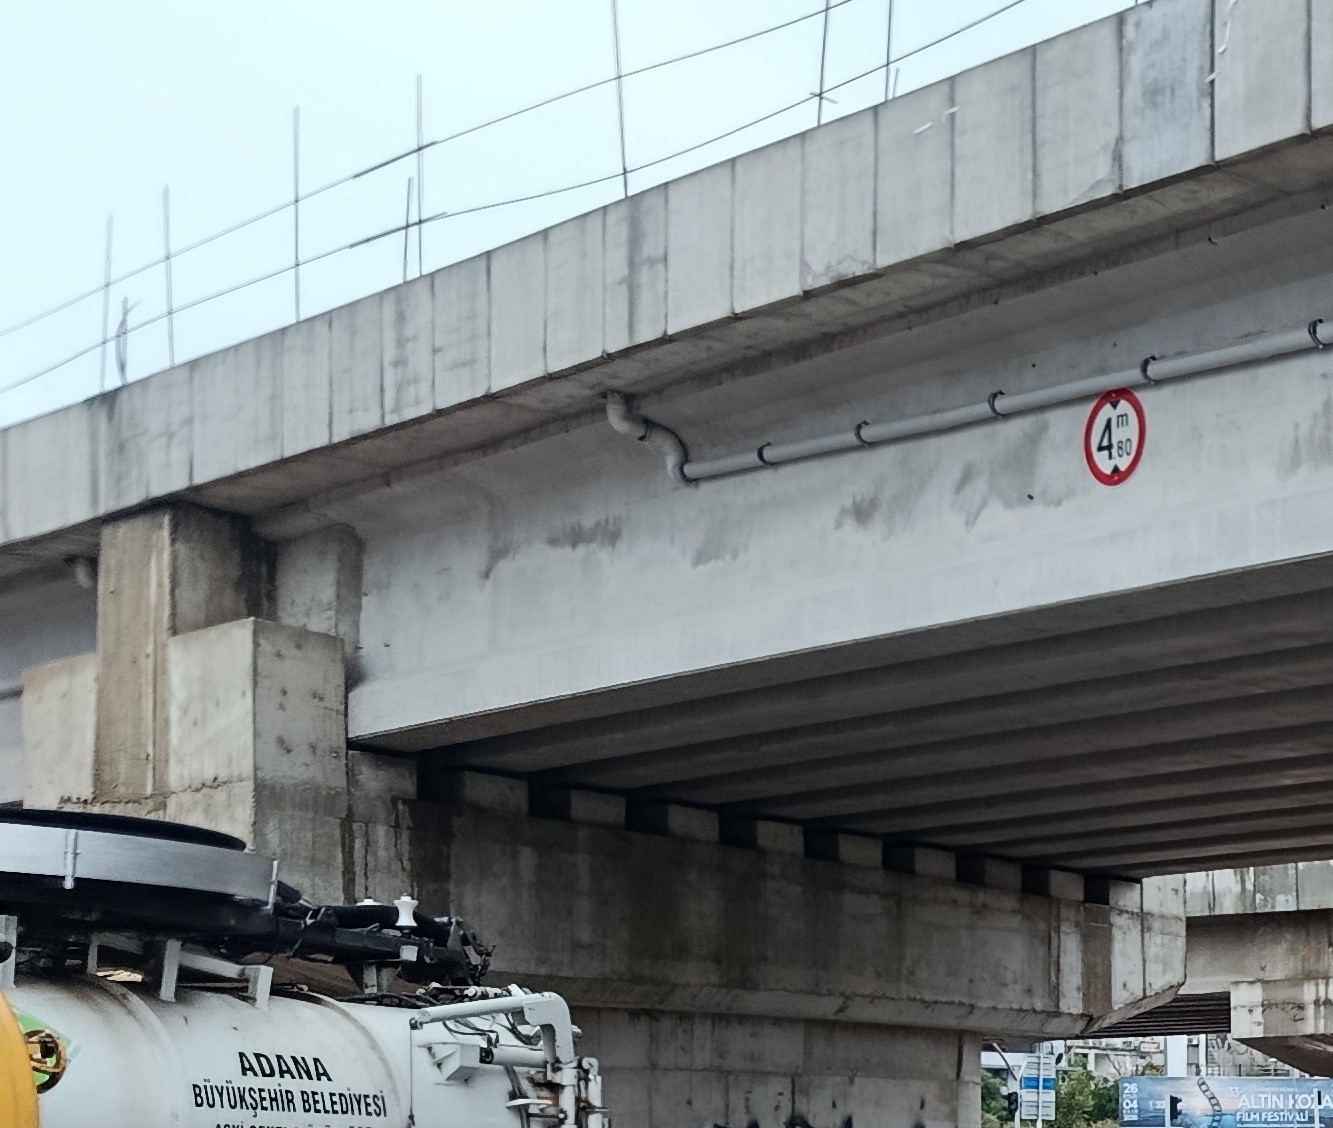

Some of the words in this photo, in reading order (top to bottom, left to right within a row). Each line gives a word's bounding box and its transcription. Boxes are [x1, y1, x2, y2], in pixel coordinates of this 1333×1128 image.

[1097, 417, 1113, 460] 4
[1116, 413, 1129, 428] m
[238, 1051, 333, 1082] ADANA
[192, 1078, 297, 1118] BÜYÜKŞEHİR
[300, 1087, 387, 1117] BELEDİYESİ
[1123, 1082, 1138, 1094] 26
[1123, 1099, 1138, 1109] 04
[1238, 1093, 1283, 1109] ALTIN
